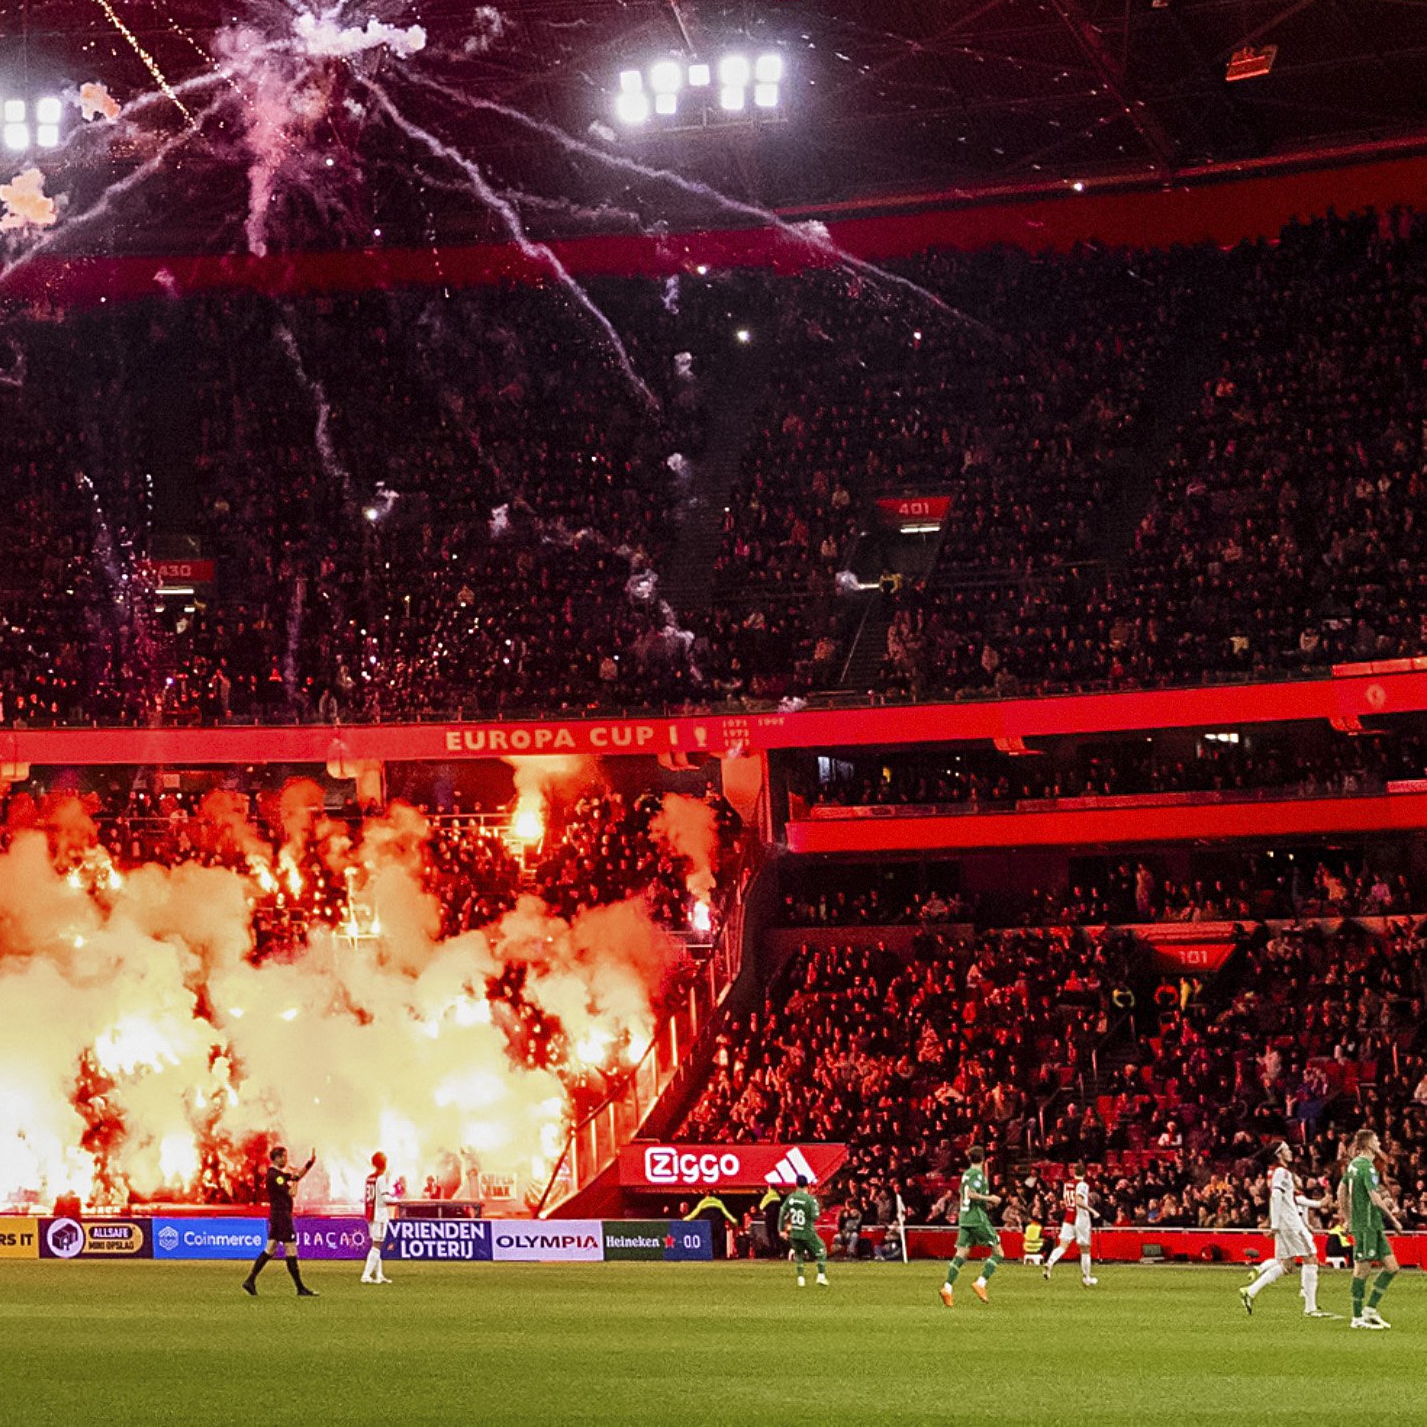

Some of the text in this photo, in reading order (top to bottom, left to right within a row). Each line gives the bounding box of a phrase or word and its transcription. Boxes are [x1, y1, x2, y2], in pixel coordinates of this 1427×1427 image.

[898, 502, 929, 516] 401
[158, 564, 192, 577] 430
[445, 724, 678, 751] EUROPA CUP I
[1179, 950, 1208, 964] 101
[93, 1226, 129, 1239] ALLSAFE
[388, 1222, 485, 1240] VRIENDEN
[20, 1233, 34, 1246] IT
[183, 1231, 263, 1247] Coinmerce
[496, 1235, 599, 1249] OLYMPIA
[605, 1235, 660, 1248] Heineken
[401, 1240, 474, 1259] LOTERIJ
